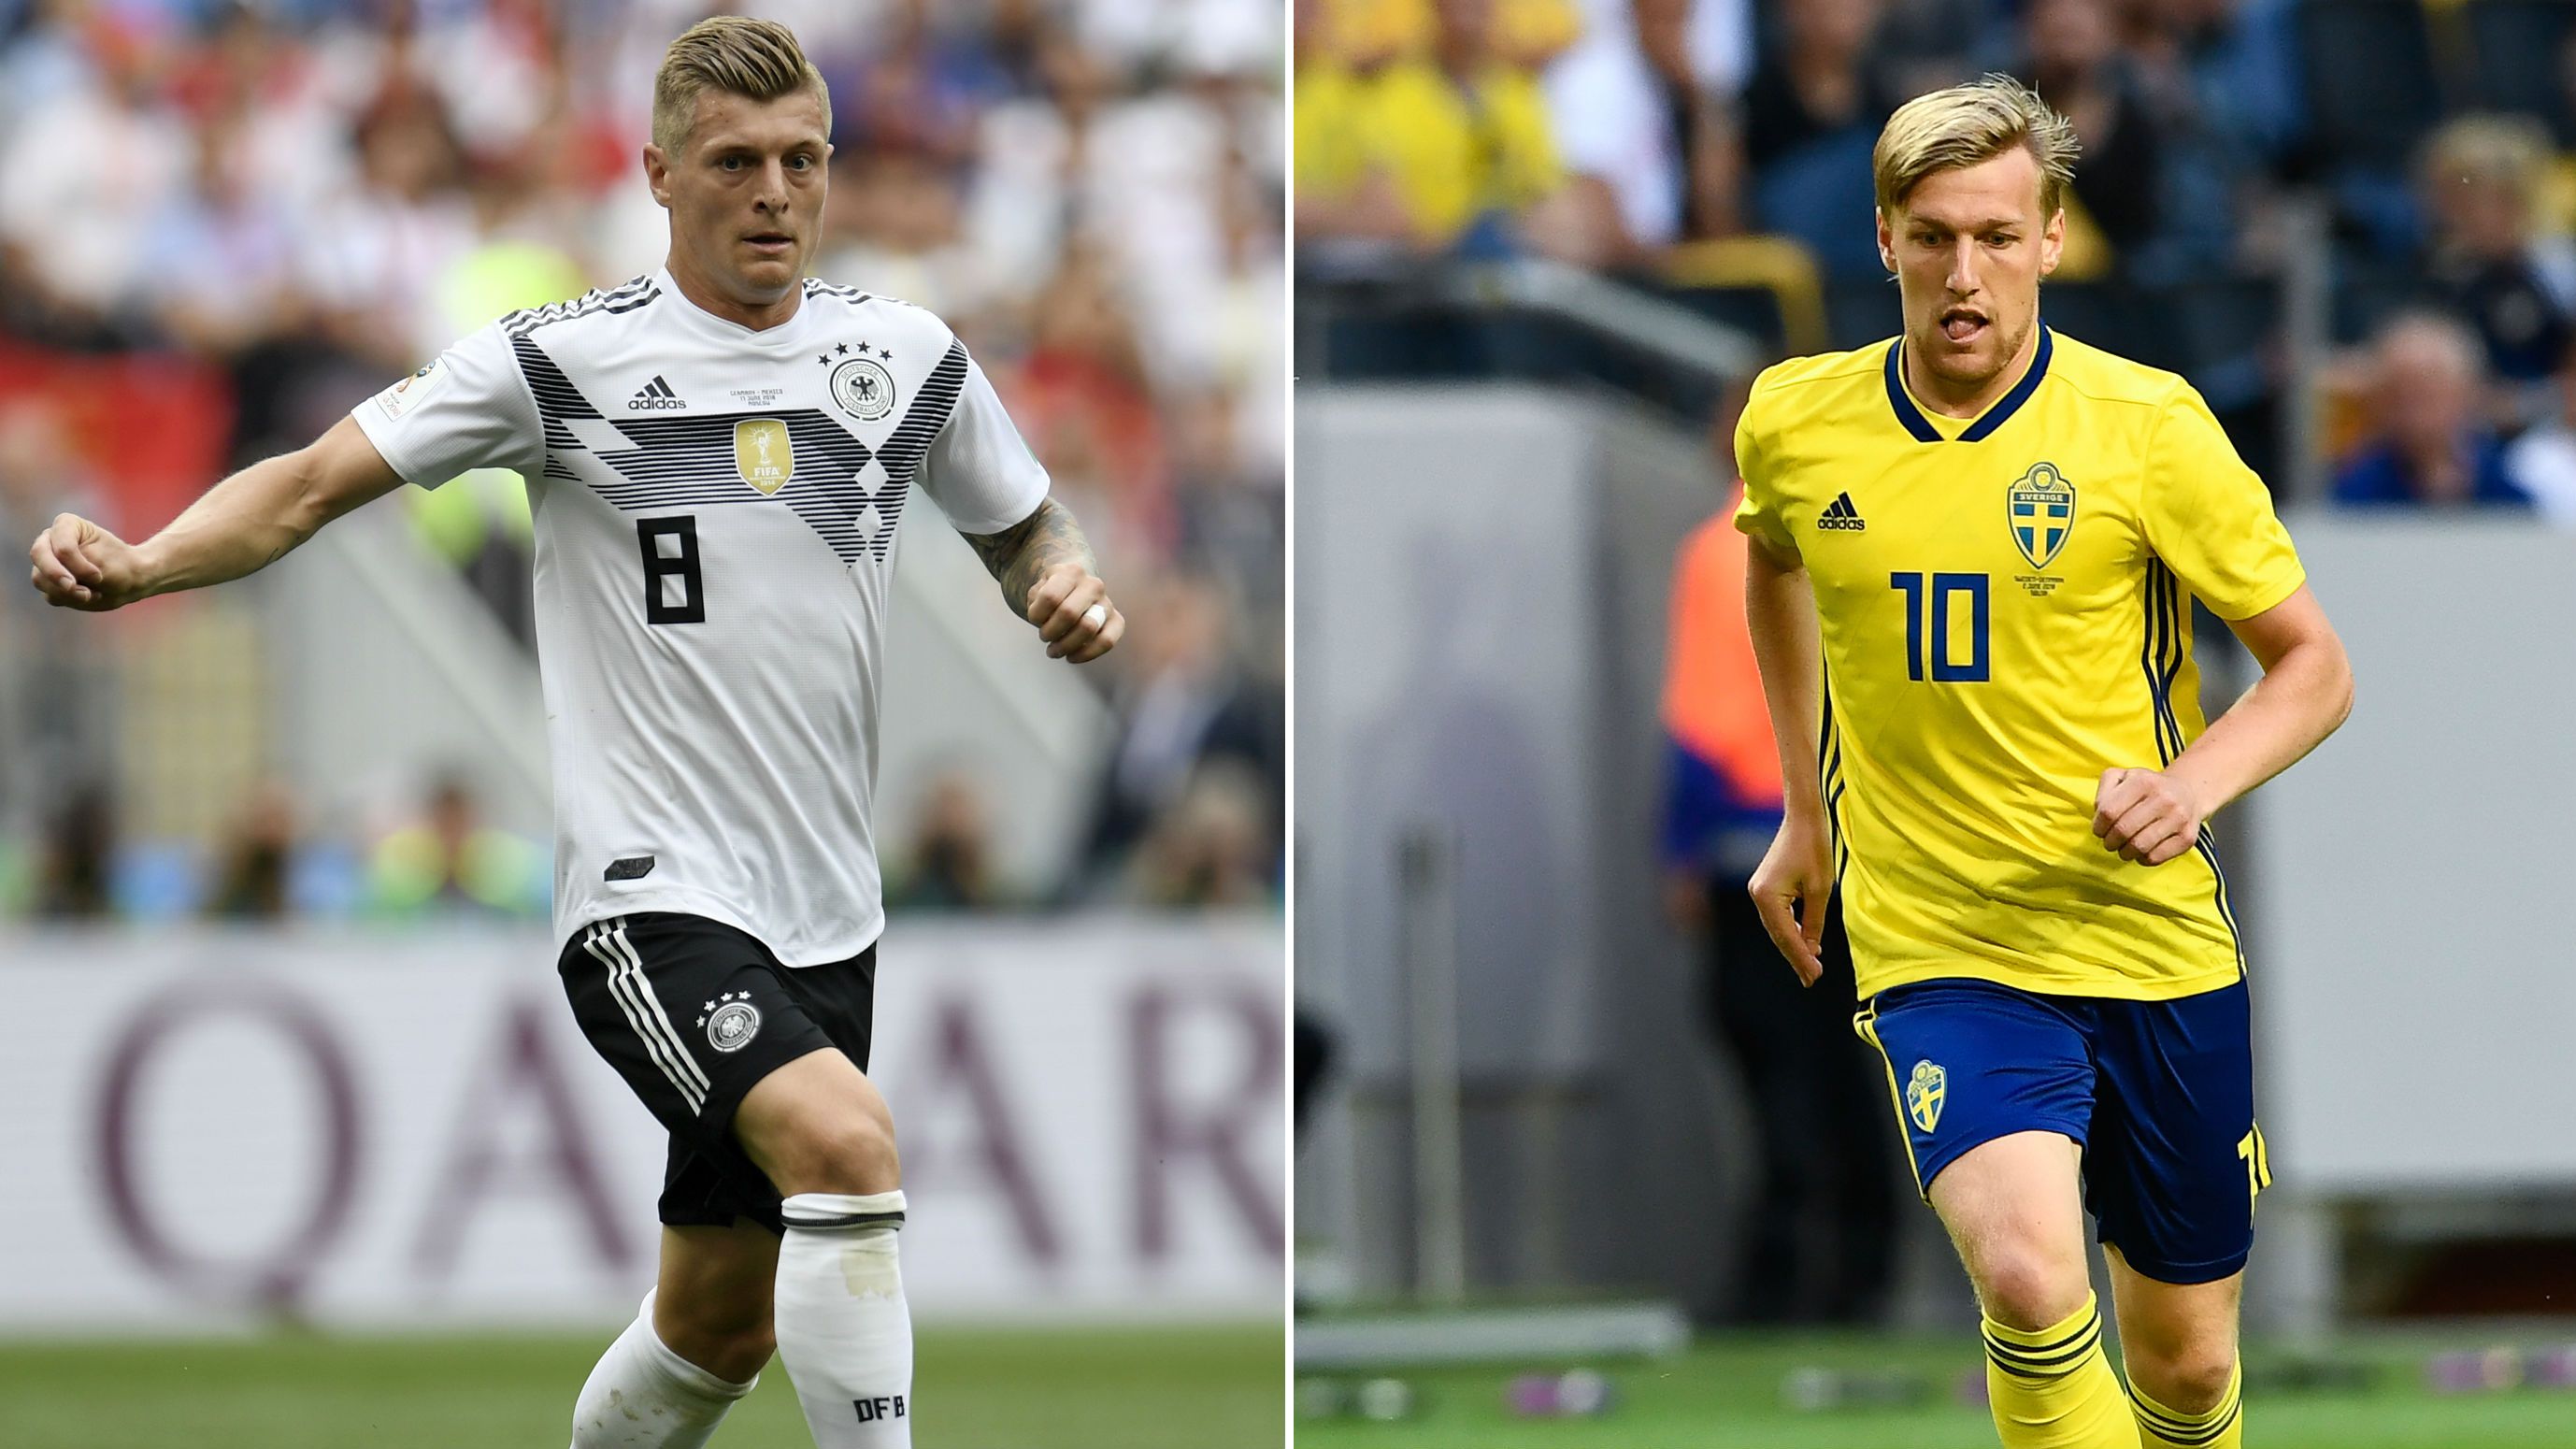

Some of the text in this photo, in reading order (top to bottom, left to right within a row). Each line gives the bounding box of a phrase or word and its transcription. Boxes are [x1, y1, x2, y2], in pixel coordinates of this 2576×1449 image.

[628, 397, 687, 409] adidas
[754, 466, 780, 477] FIFA
[2019, 493, 2064, 501] SVERIGE
[1817, 515, 1866, 531] adidas
[636, 515, 705, 624] 8
[1890, 572, 1990, 681] 10
[86, 980, 1285, 1309] QAAR
[852, 1396, 905, 1423] DFB
